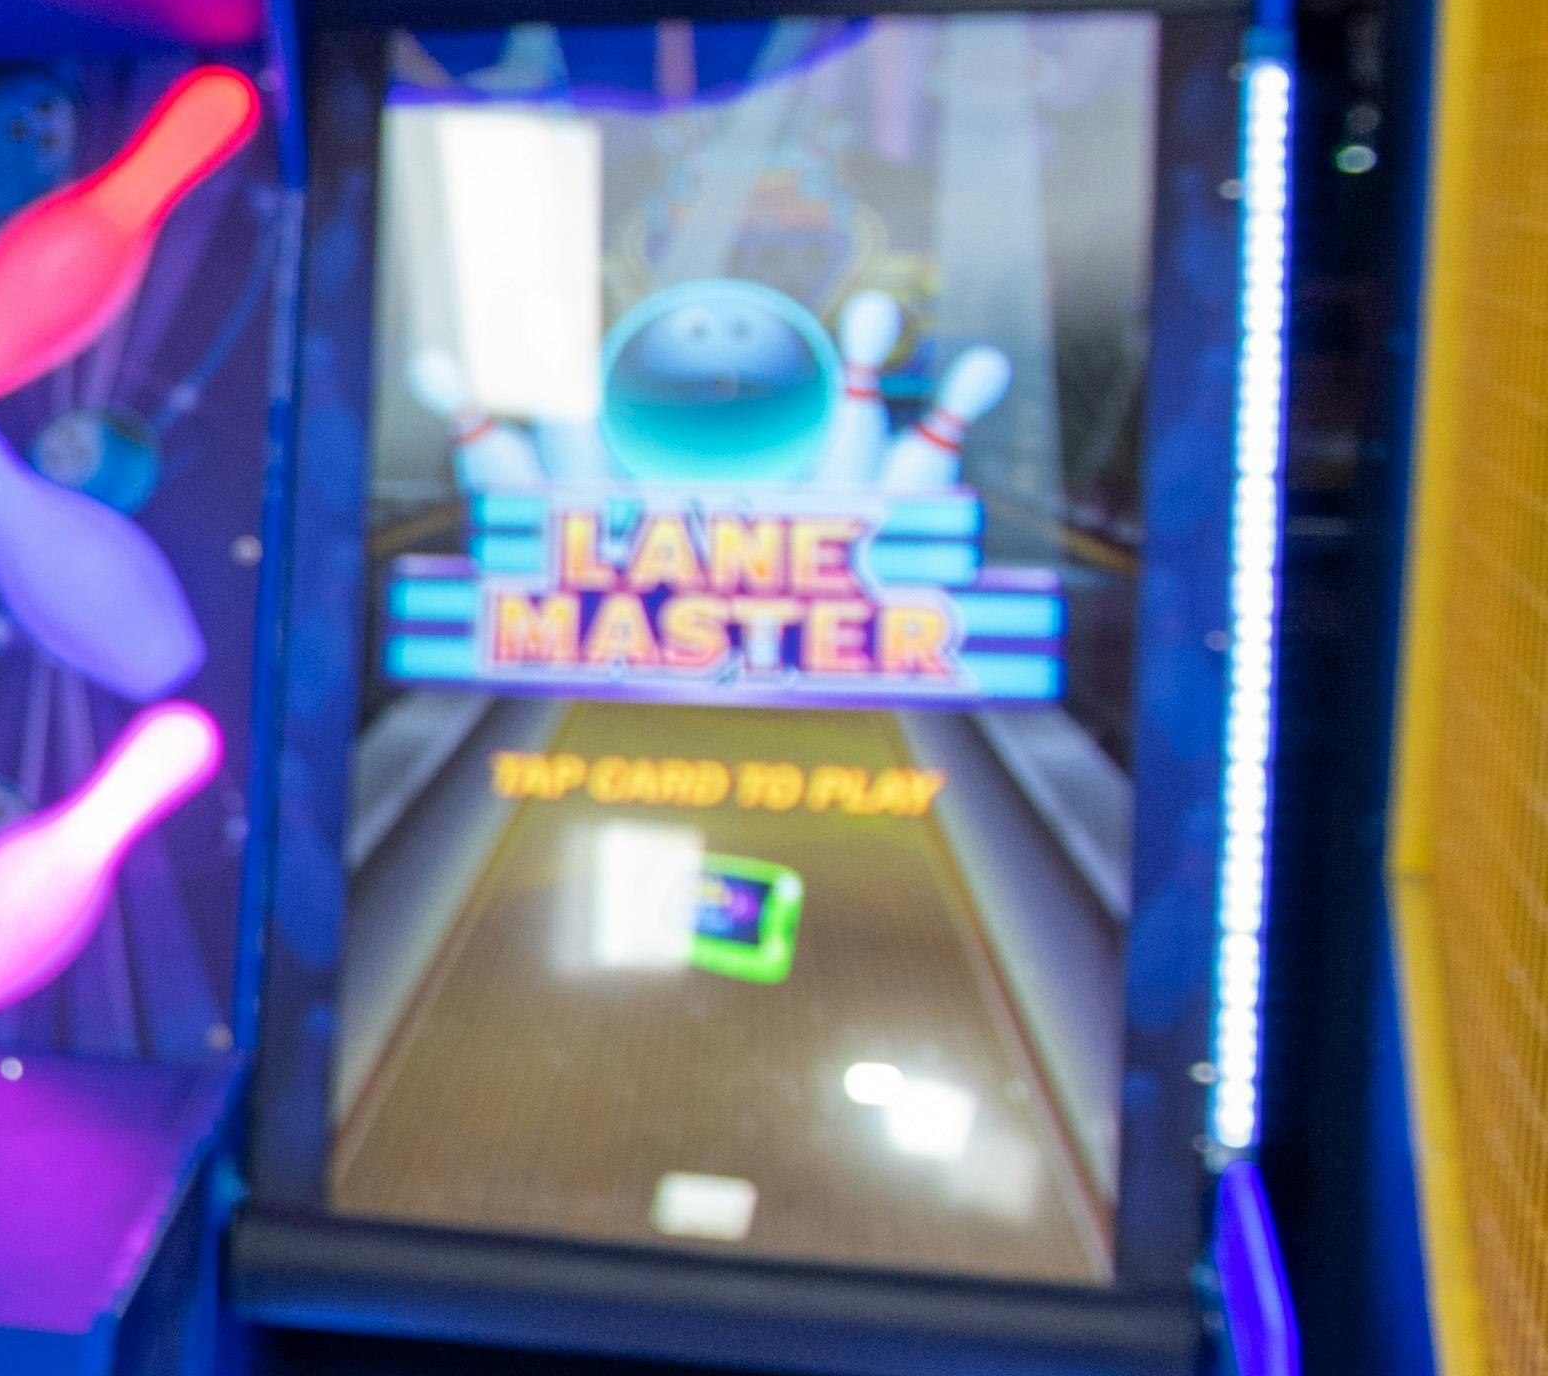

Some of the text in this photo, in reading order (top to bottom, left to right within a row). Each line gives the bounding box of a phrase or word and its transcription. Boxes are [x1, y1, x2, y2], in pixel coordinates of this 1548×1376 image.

[560, 514, 868, 594] LANE
[488, 592, 956, 680] MASTER
[490, 750, 945, 818] TAP CARD TO PLAY
